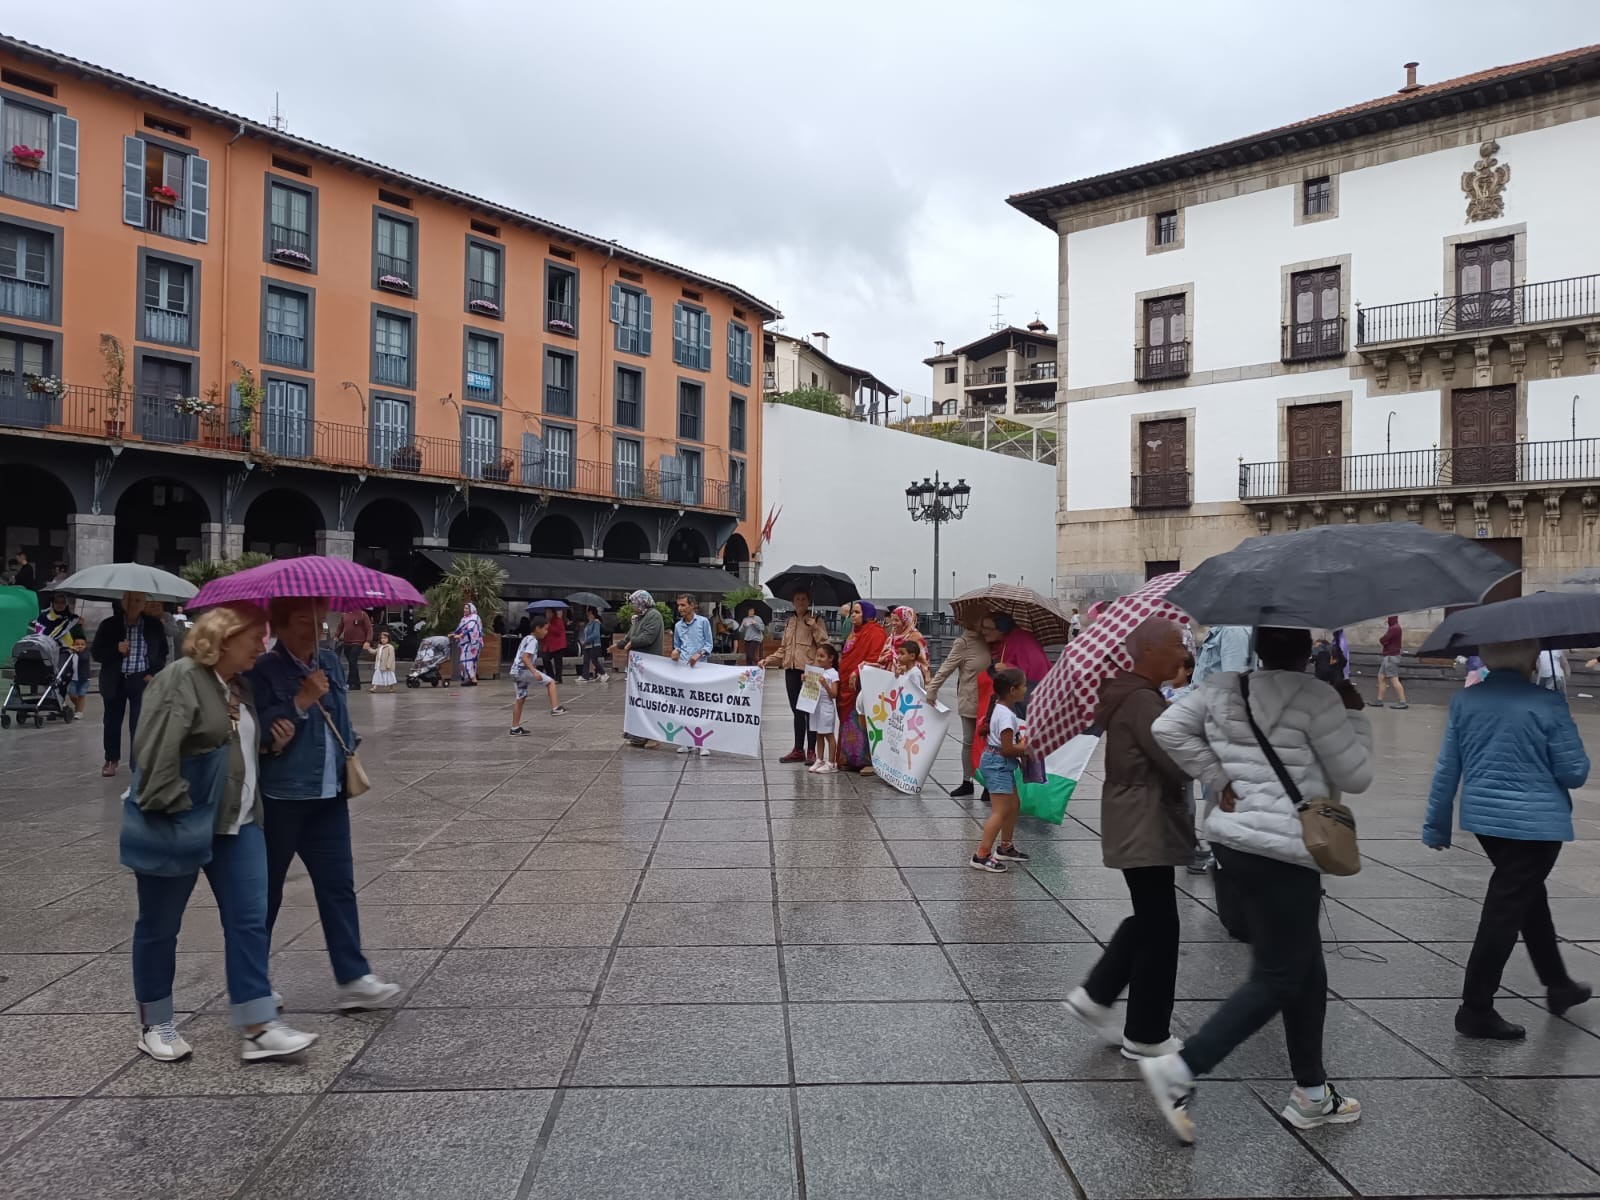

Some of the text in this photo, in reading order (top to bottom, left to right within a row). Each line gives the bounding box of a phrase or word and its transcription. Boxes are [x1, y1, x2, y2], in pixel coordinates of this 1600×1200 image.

[637, 681, 751, 706] HARRERA ABEGI ONA
